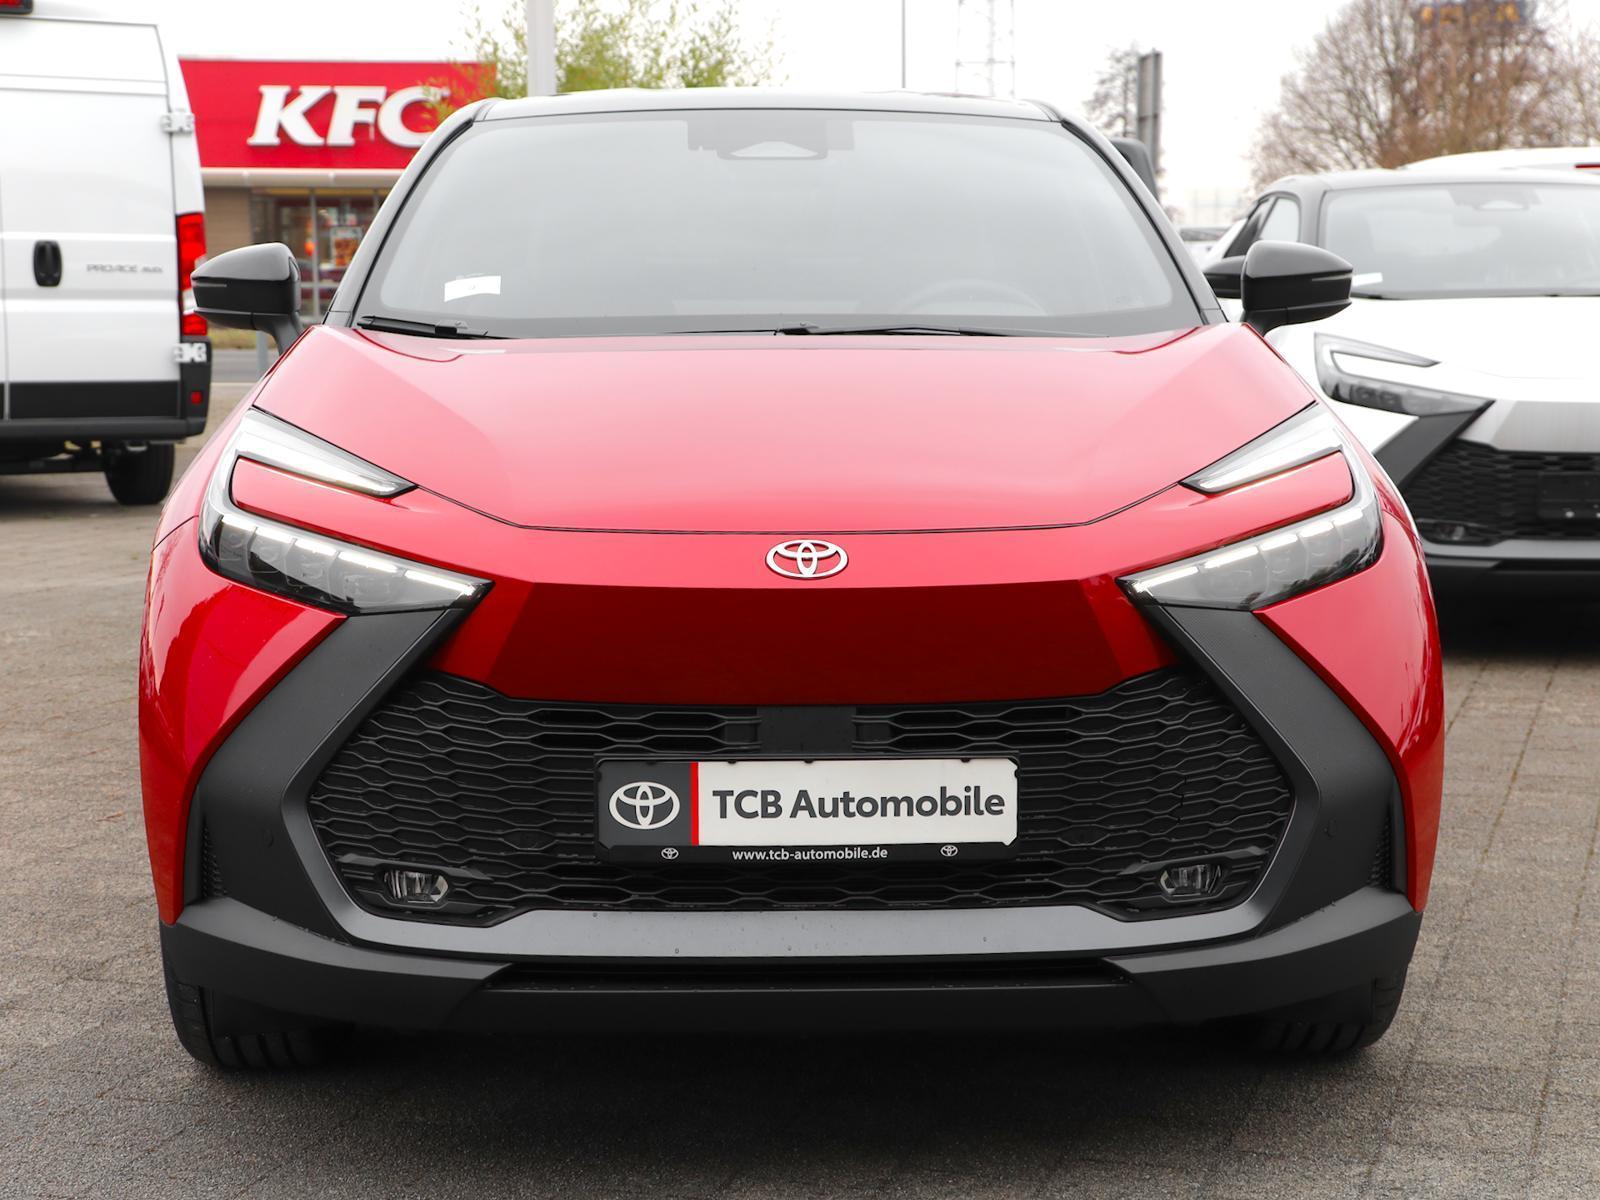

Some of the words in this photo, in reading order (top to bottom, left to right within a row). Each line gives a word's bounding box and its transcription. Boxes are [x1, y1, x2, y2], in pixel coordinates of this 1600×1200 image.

[247, 85, 450, 148] KFC
[712, 789, 783, 819] TCB
[789, 785, 1005, 818] Automobile
[732, 846, 888, 860] www.tcb-automobile.de
